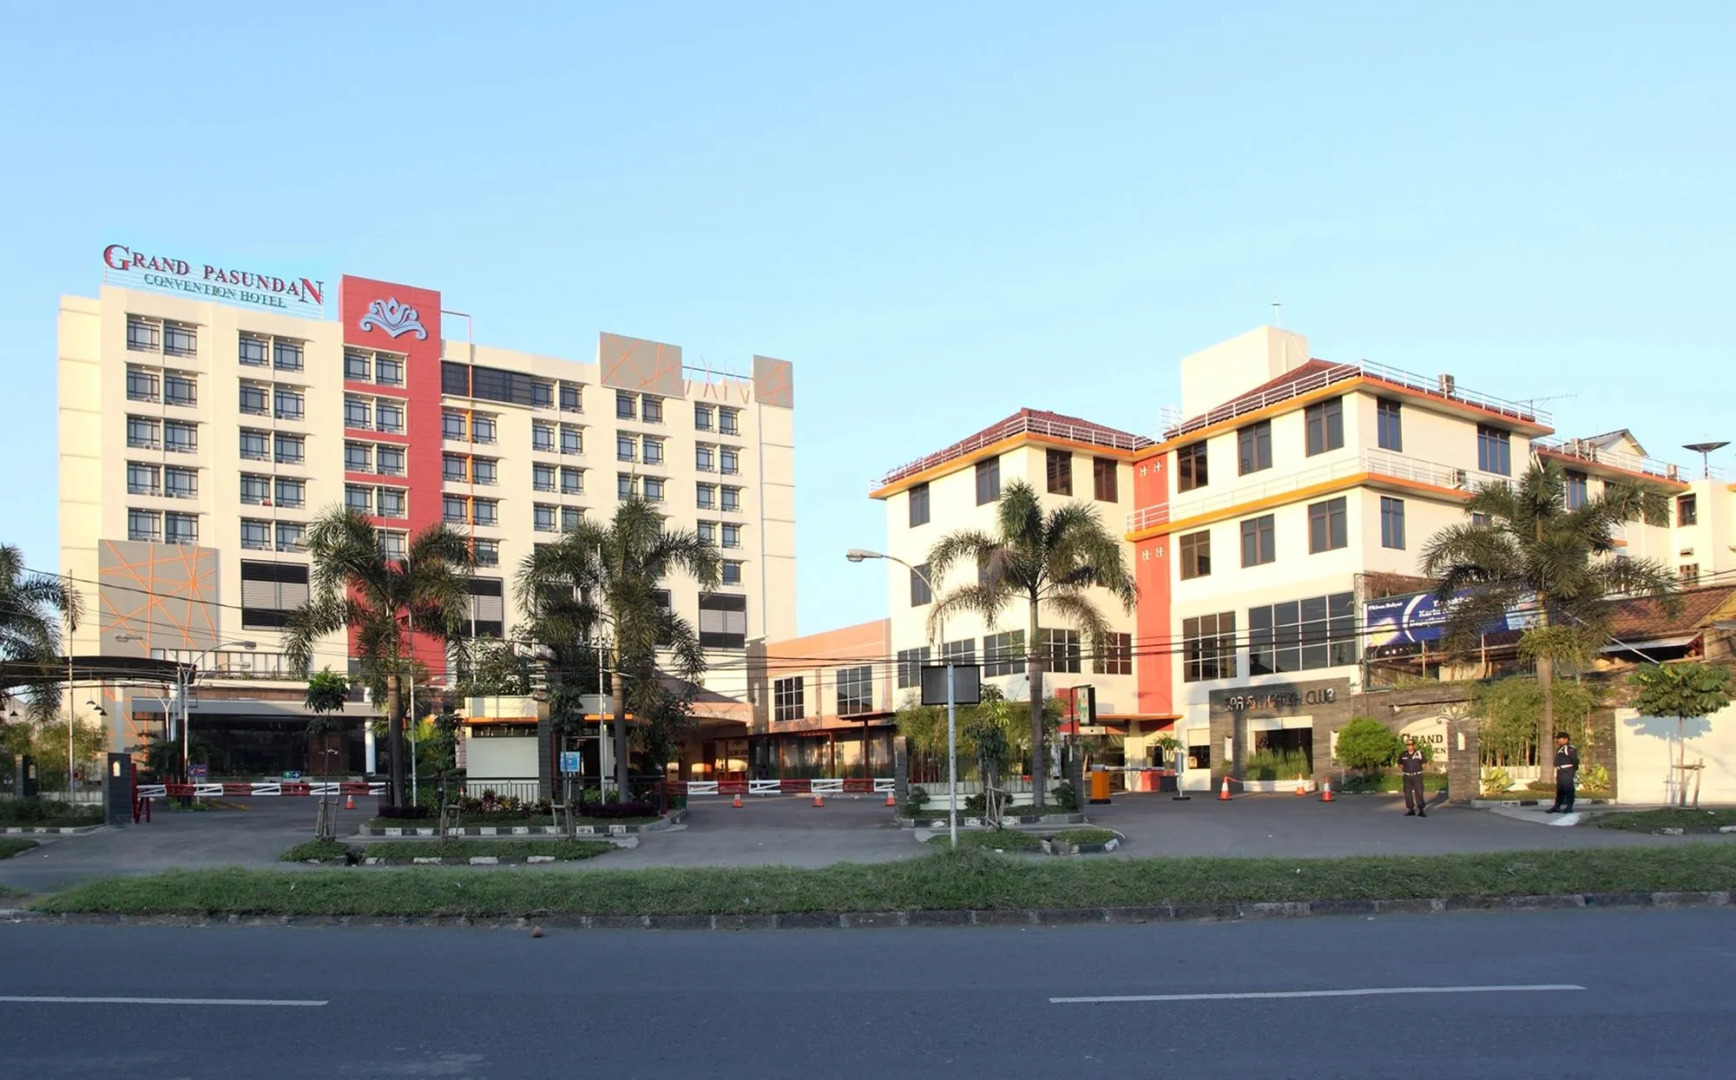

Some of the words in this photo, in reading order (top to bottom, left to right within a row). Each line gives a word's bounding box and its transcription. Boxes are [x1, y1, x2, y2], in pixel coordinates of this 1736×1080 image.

[103, 244, 190, 276] GRAND
[203, 264, 324, 305] PASUNDAN
[144, 273, 236, 300] CONVENTION
[240, 290, 287, 309] HOTEL
